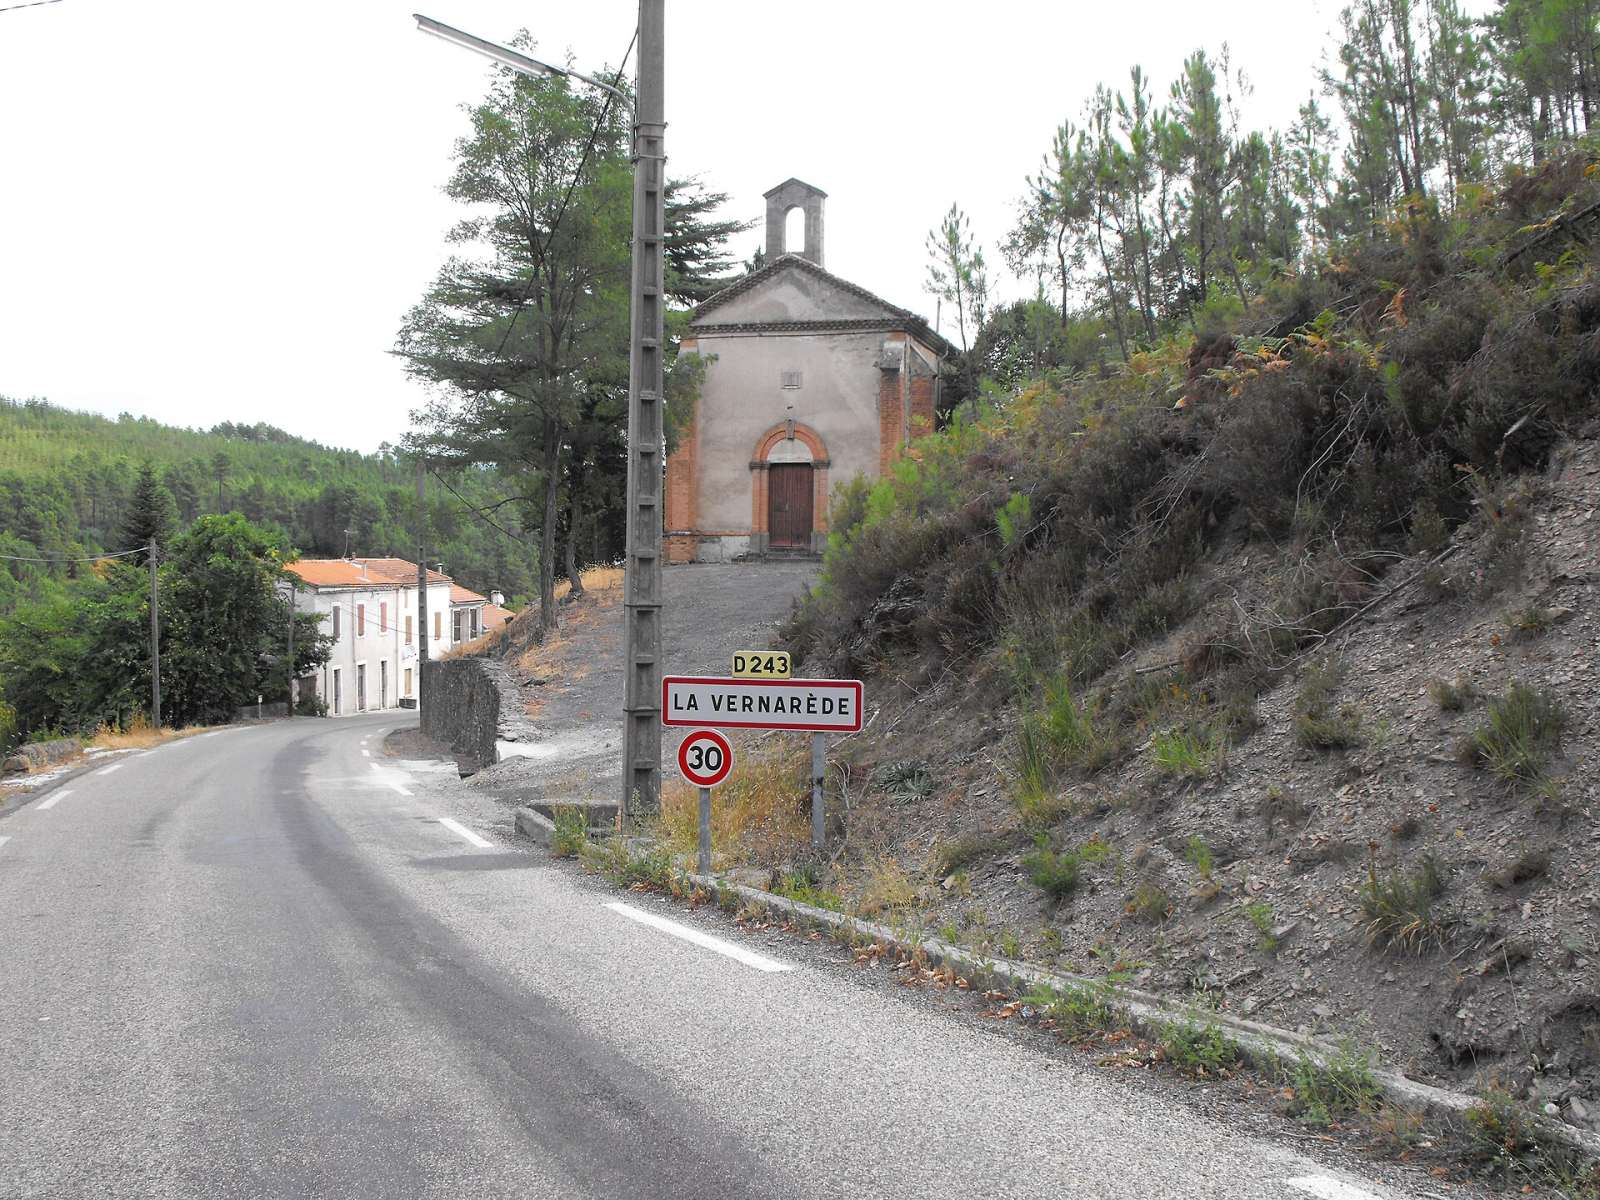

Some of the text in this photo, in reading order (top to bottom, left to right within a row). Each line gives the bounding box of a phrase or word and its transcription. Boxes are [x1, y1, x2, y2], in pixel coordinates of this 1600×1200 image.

[673, 692, 849, 715] LA VERNARÈDE
[688, 745, 723, 771] 30
